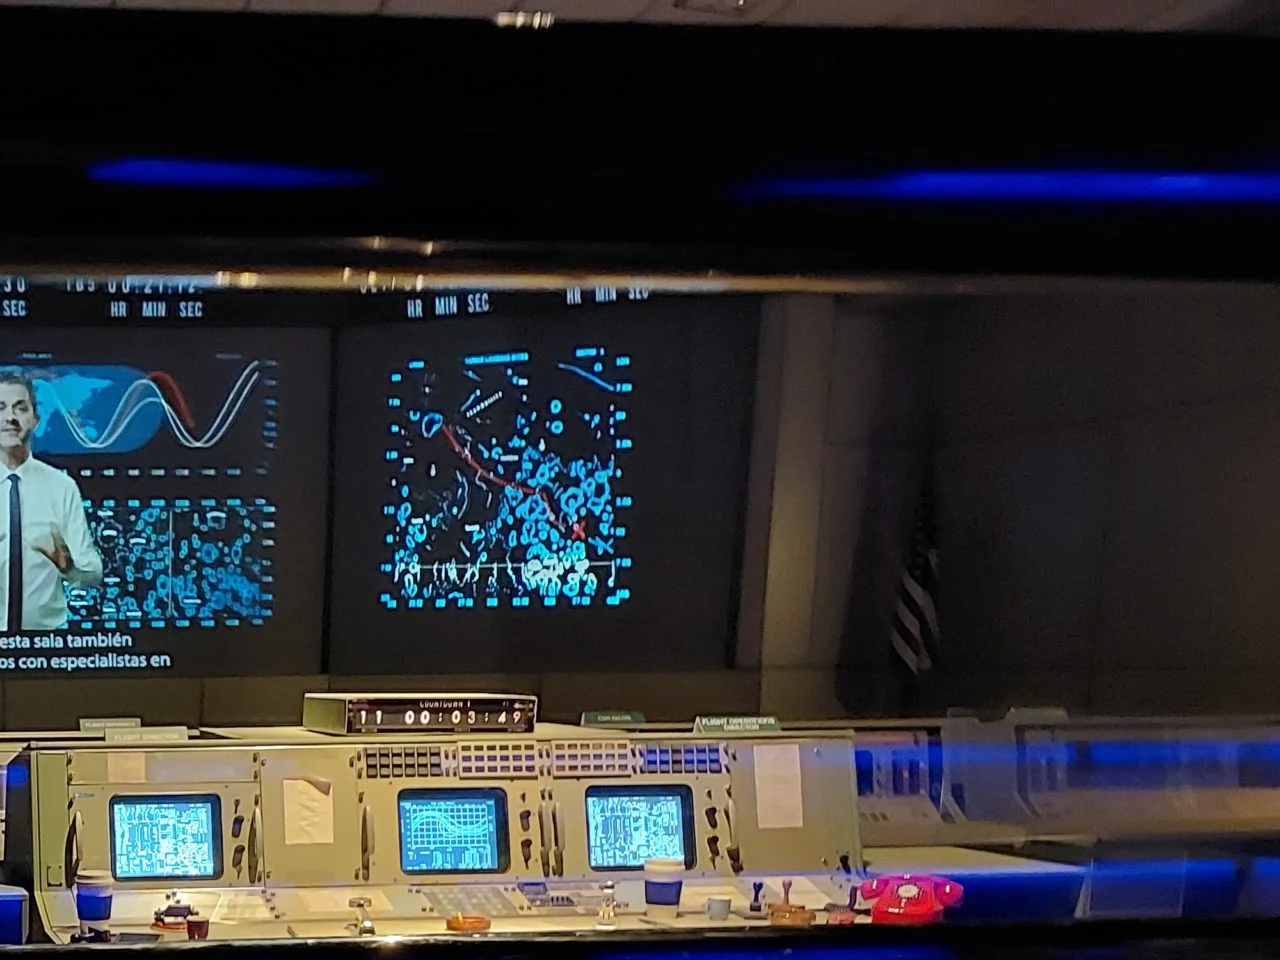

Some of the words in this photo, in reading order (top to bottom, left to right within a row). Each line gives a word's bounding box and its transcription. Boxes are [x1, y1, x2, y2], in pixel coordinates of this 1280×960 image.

[566, 286, 582, 306] HR
[595, 285, 617, 303] MIN
[2, 300, 27, 317] SEC
[110, 301, 127, 318] HR
[142, 301, 166, 318] MIN
[179, 301, 202, 318] SEC
[407, 299, 423, 319] HR
[435, 295, 457, 316] MIN
[468, 292, 489, 313] SEC
[0, 635, 30, 650] esta
[34, 632, 64, 649] sala
[67, 631, 133, 649] también
[18, 657, 48, 670] con
[50, 653, 147, 672] especialistas
[150, 655, 171, 668] en
